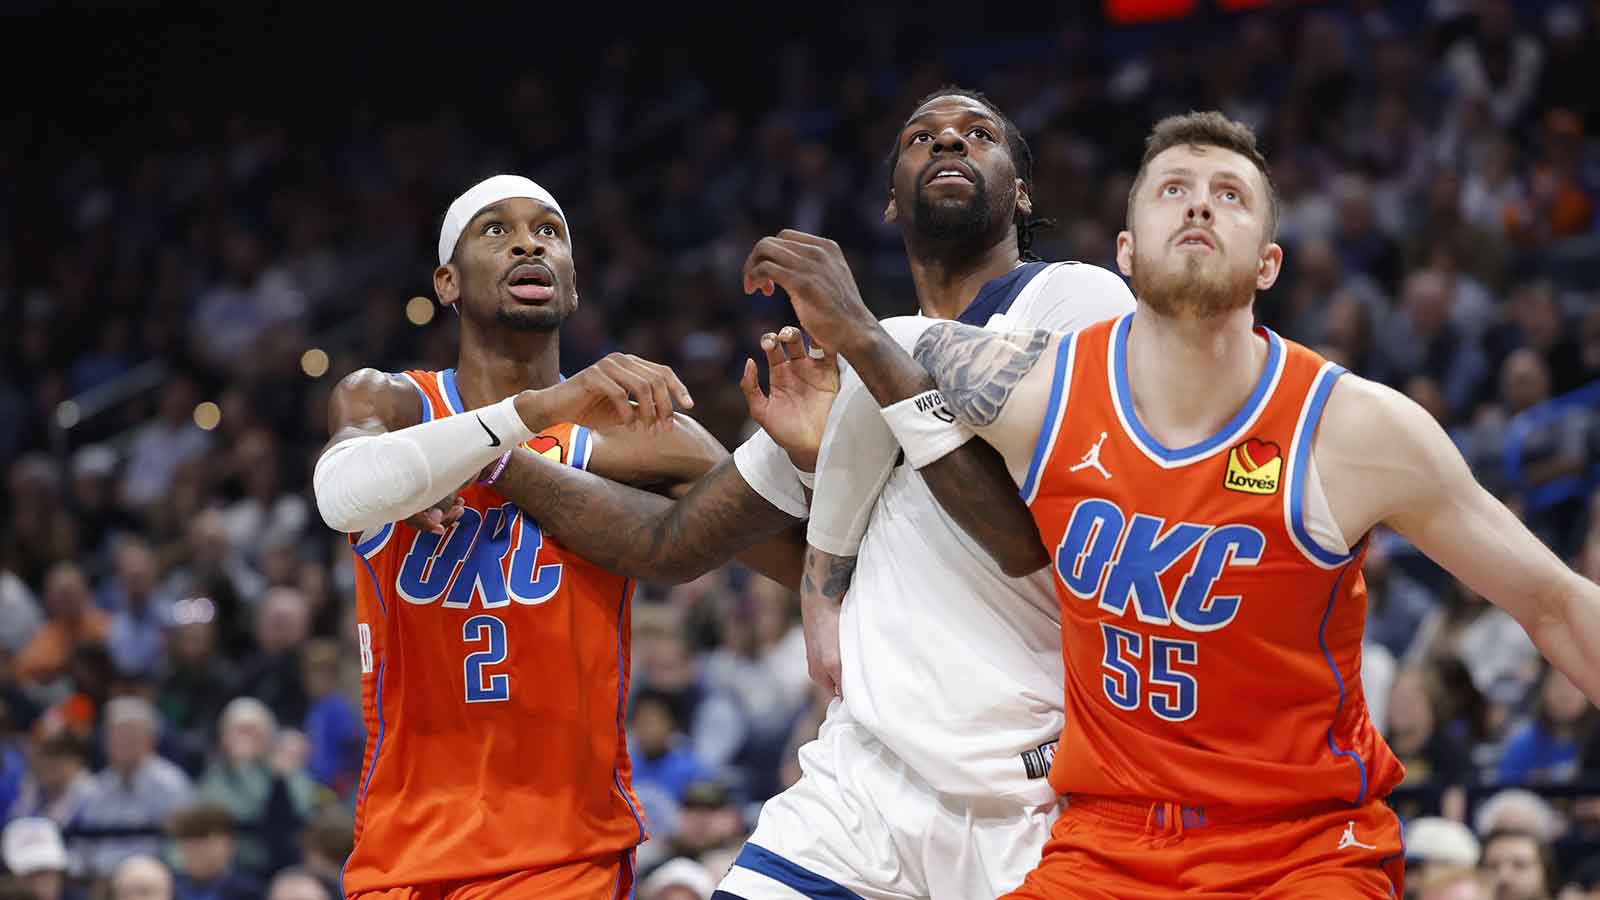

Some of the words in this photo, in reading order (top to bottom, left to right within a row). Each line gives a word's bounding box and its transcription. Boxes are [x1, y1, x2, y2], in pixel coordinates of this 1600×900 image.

[914, 391, 945, 413] RAYA
[396, 502, 563, 609] OKC
[1056, 498, 1266, 632] OKC
[463, 614, 510, 703] 2
[1101, 623, 1198, 722] 55
